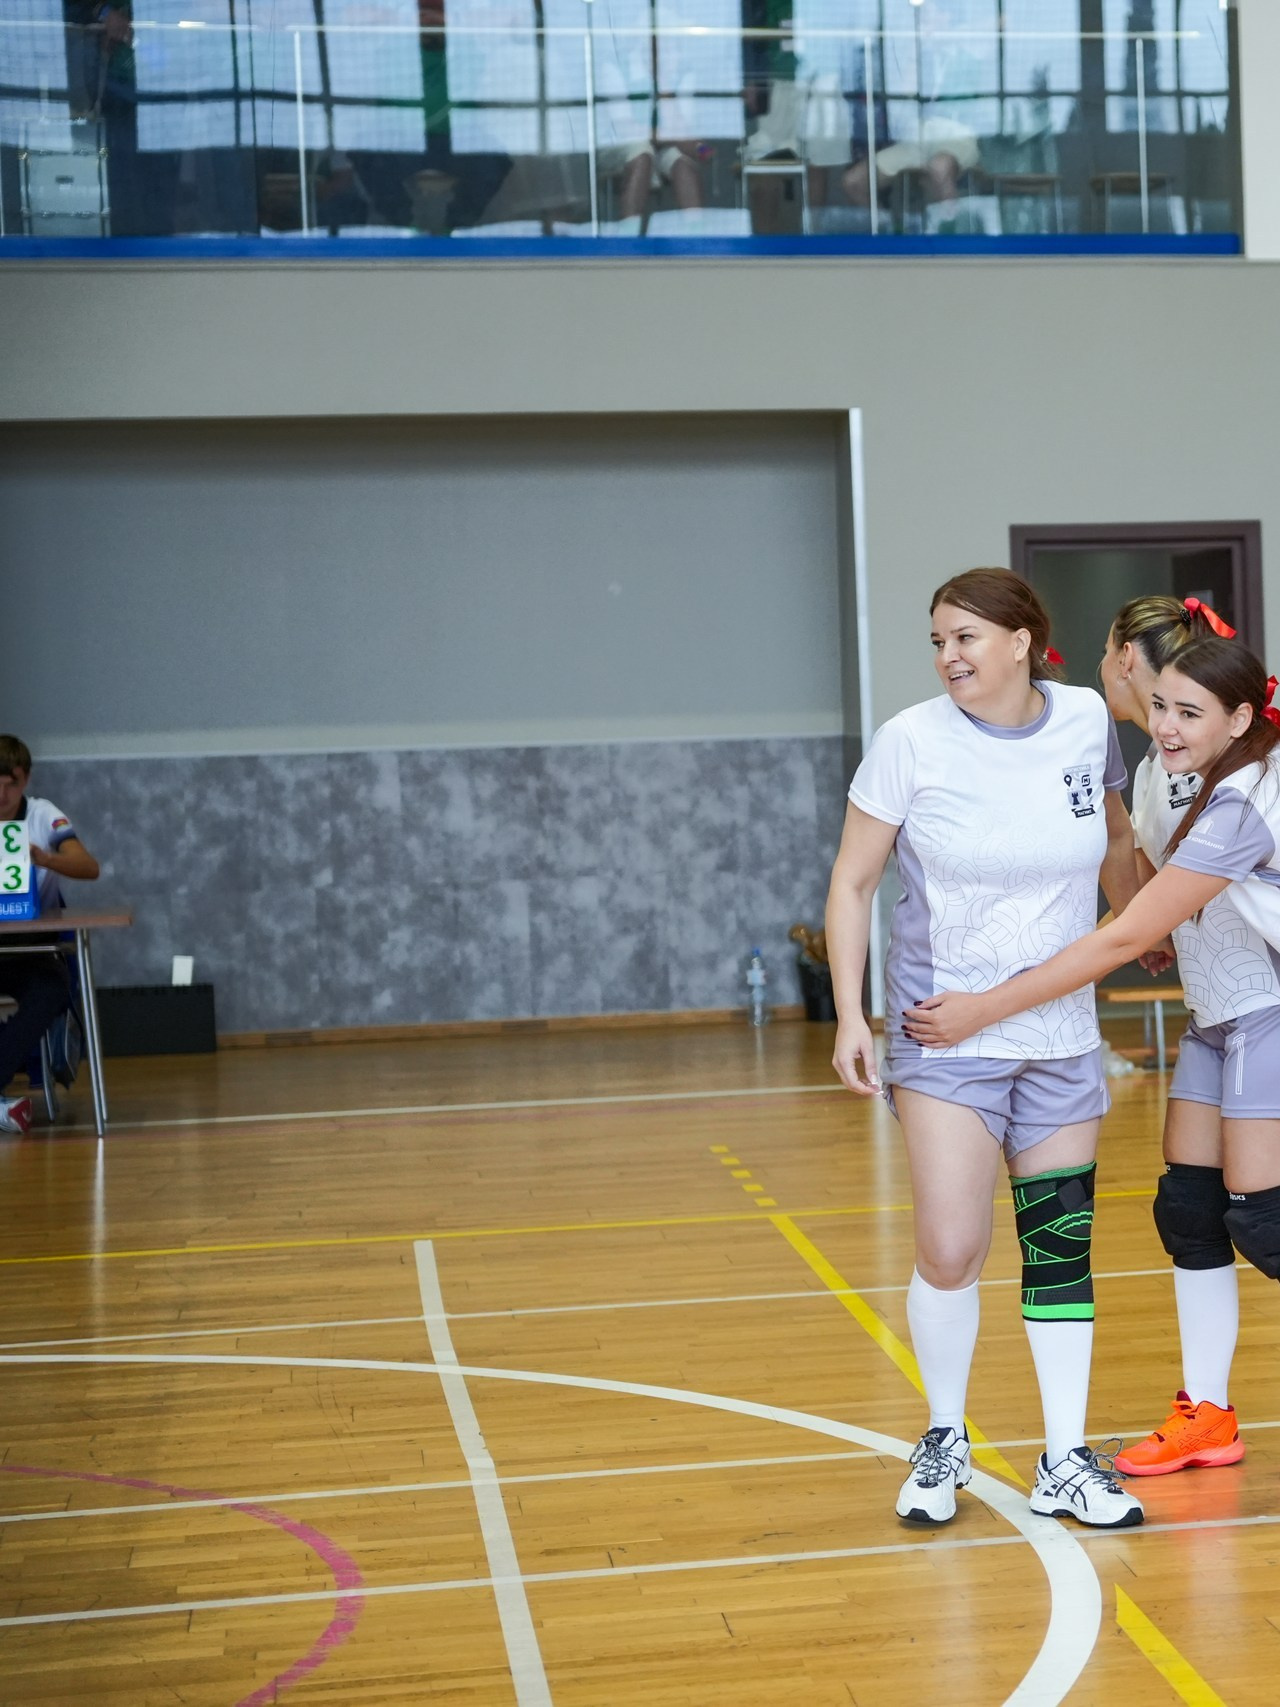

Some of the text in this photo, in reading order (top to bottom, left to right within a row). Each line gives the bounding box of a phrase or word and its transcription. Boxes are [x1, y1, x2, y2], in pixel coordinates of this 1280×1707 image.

[1173, 797, 1193, 807] МАГНИТ
[1192, 837, 1225, 850] КОМПАНИЯ
[3, 865, 22, 890] 3
